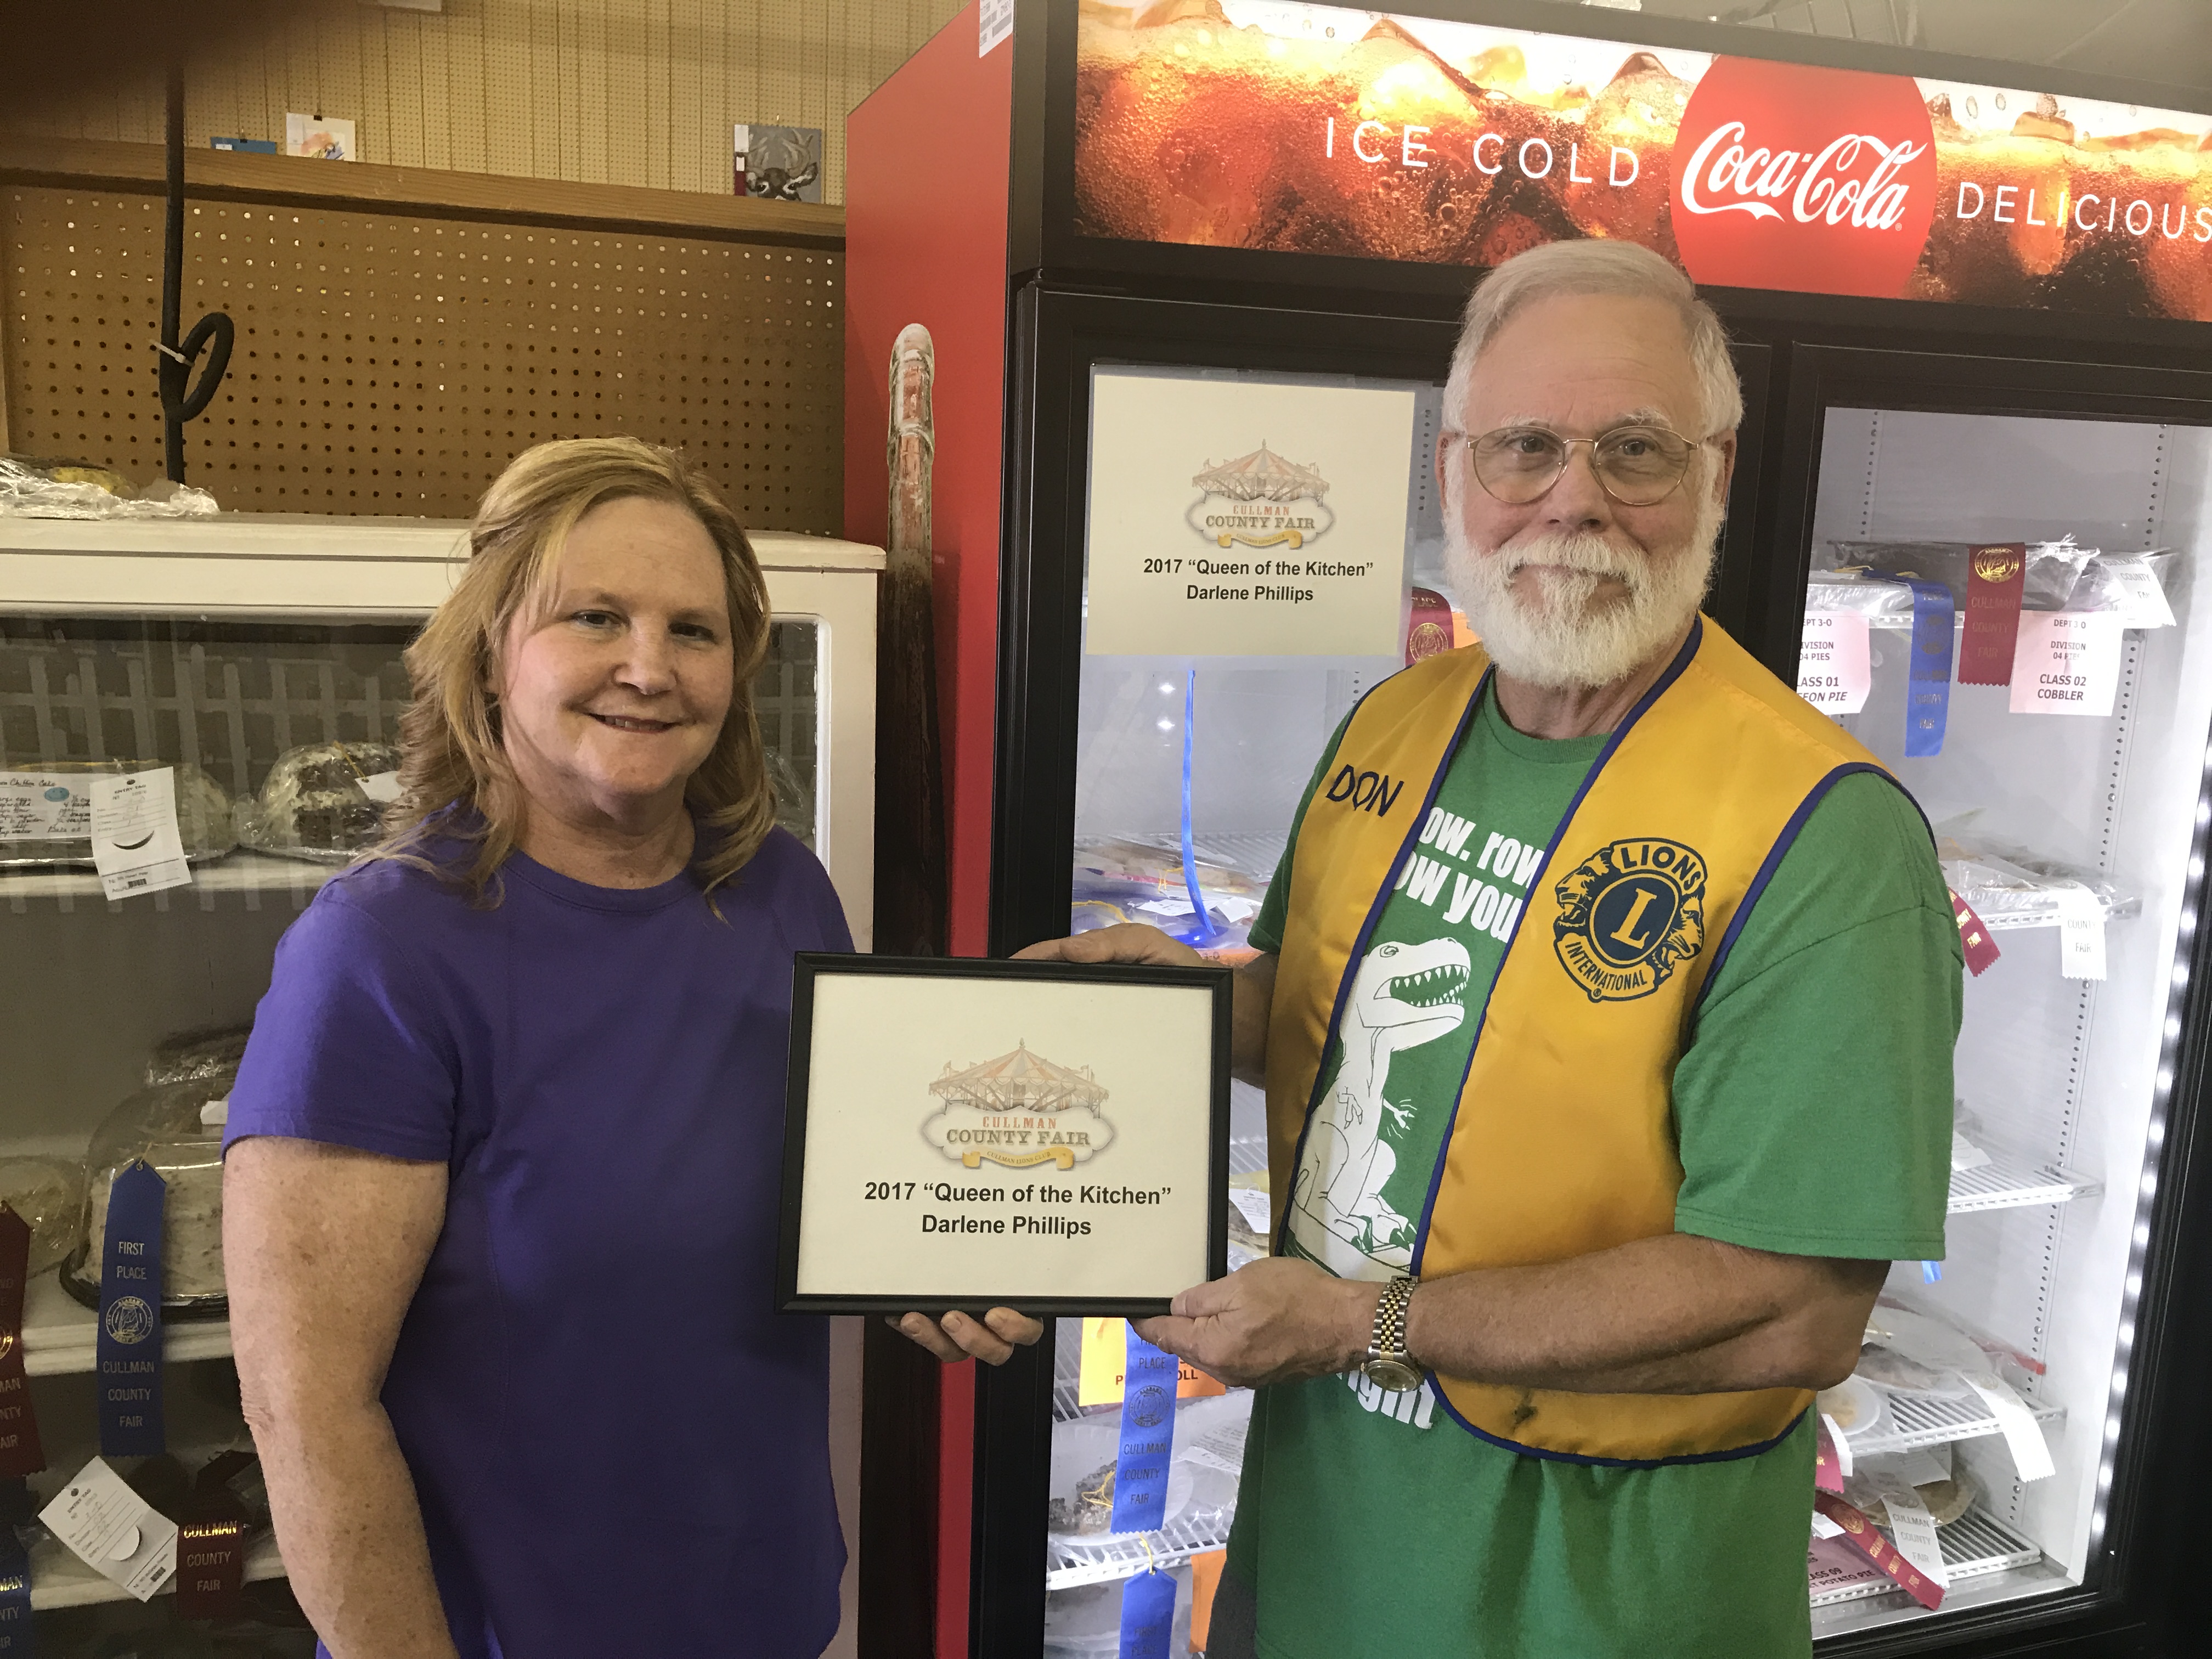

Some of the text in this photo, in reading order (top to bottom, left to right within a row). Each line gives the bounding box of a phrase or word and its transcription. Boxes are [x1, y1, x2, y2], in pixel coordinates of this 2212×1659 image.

[1327, 117, 1639, 187] ICE COLD
[1681, 121, 1928, 229] Coca-Cola
[1957, 182, 2212, 242] DELICIOUS
[1233, 505, 1289, 515] CULLMAN
[1205, 515, 1315, 529] COUNTY FAIR
[1143, 558, 1374, 577] 2017 “Queen of the Kitchen”
[2103, 557, 2144, 566] CULLMAN
[2120, 572, 2151, 582] COUNTY
[1187, 585, 1313, 603] Darlene Phillips
[1971, 596, 2016, 610] CULLMAN
[1972, 622, 2008, 633] COUNTY
[2053, 619, 2072, 627] DEPT
[1978, 647, 1999, 658] FAIR
[2051, 641, 2086, 651] DIVISION
[1826, 676, 1839, 686] 01
[2040, 674, 2086, 686] CLASS 02
[1829, 692, 1848, 701] PIE
[2038, 689, 2084, 701] COBBLER
[1325, 764, 1404, 817] DON
[1418, 807, 1476, 861] ow.
[1620, 844, 1701, 891] LIONS
[1610, 888, 1657, 950] L
[2075, 942, 2091, 953] FAIR
[1565, 941, 1647, 991] INTERNATIONAL
[982, 1116, 1057, 1129] CULLMAN
[946, 1129, 1090, 1145] COUNTY FAIR
[987, 1151, 1015, 1164] CULLMAN
[1035, 1152, 1051, 1161] CLUB
[865, 1182, 1171, 1204] 2017 “Queen of the Kitchen”
[922, 1215, 1092, 1239] Darlene Phillips
[119, 1241, 144, 1255] FIRST
[116, 1265, 147, 1280] PLACE
[103, 1361, 155, 1373] CULLMAN
[1139, 1357, 1166, 1369] PLACE
[1177, 1369, 1198, 1380] OLL
[108, 1388, 151, 1401] COUNTY
[119, 1415, 143, 1427] FAIR
[0, 1434, 19, 1449] AIR
[1124, 1443, 1166, 1455] CULLMAN
[1125, 1468, 1160, 1480] COUNTY
[1131, 1493, 1149, 1505] FAIR
[1893, 1514, 1930, 1528] CULLMAN
[184, 1520, 237, 1539] CULLMAN
[1901, 1532, 1931, 1545] COUNTY
[187, 1551, 232, 1568] COUNTY
[1912, 1551, 1930, 1562] FAIR
[1809, 1570, 1829, 1581] LASS
[1819, 1574, 1858, 1585] POTATO
[1857, 1570, 1875, 1578] PIE
[196, 1579, 221, 1592] FAIR
